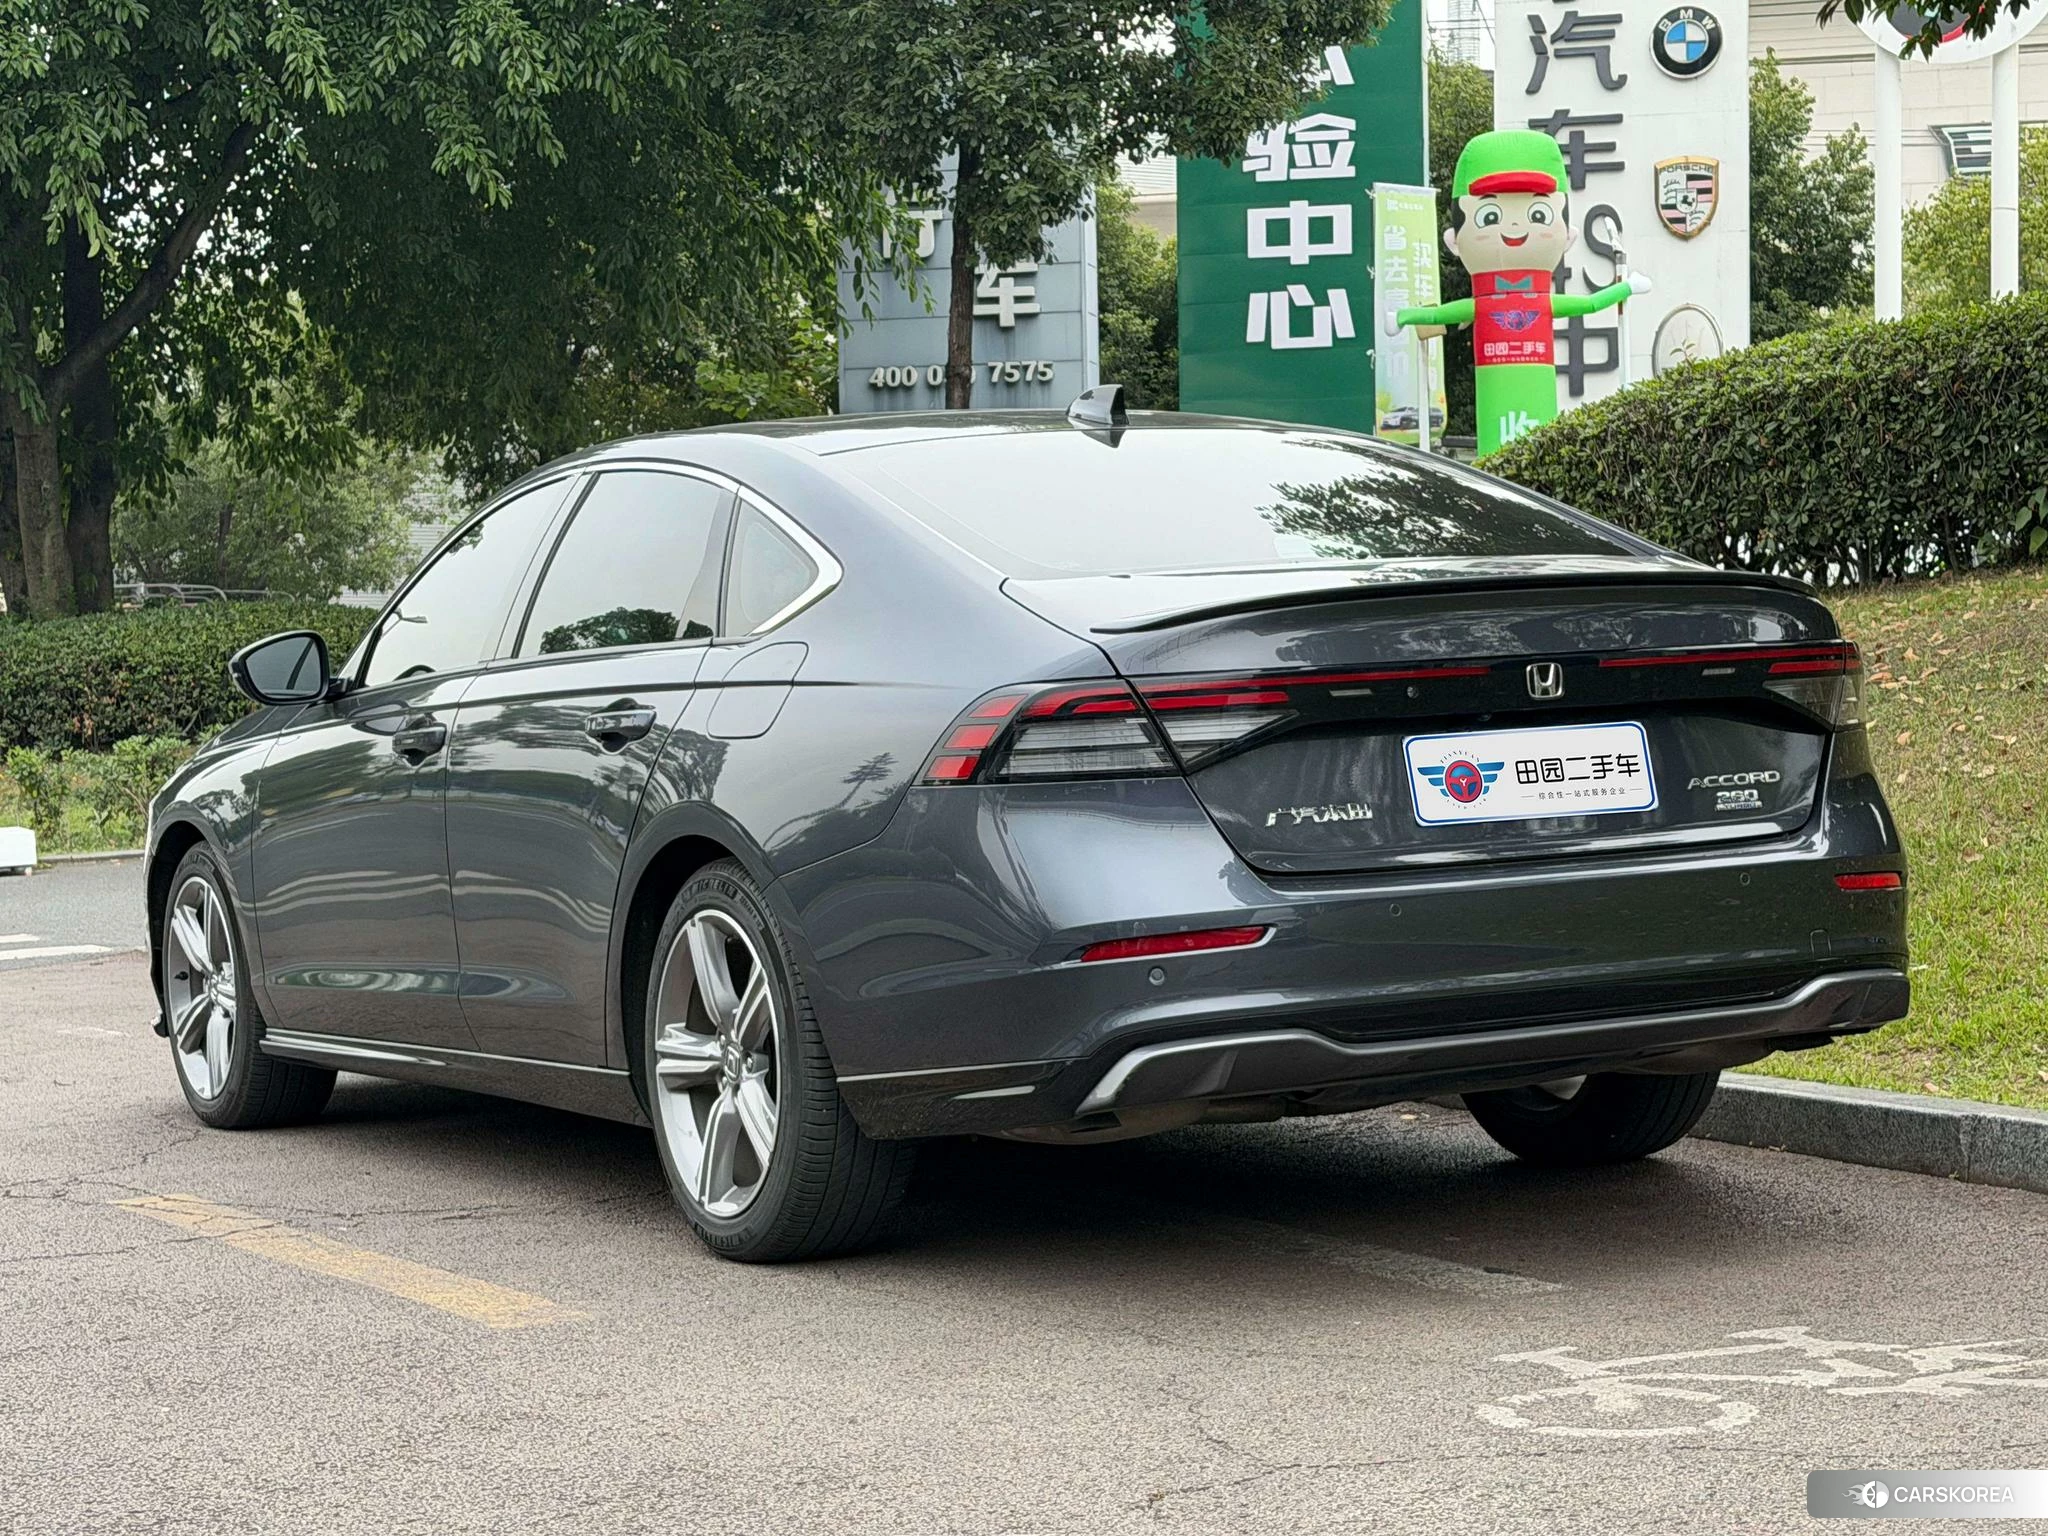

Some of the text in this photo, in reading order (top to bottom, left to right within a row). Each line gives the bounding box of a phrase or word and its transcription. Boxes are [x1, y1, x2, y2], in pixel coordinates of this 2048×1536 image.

[1659, 9, 1716, 31] BMW
[1659, 164, 1713, 175] PORSCHE
[1242, 45, 1357, 350] 验中心
[869, 366, 918, 388] 400
[988, 361, 1054, 383] 7575
[1515, 753, 1640, 784] 田园二手车
[1687, 770, 1781, 790] ACCORD
[1716, 789, 1759, 803] 260
